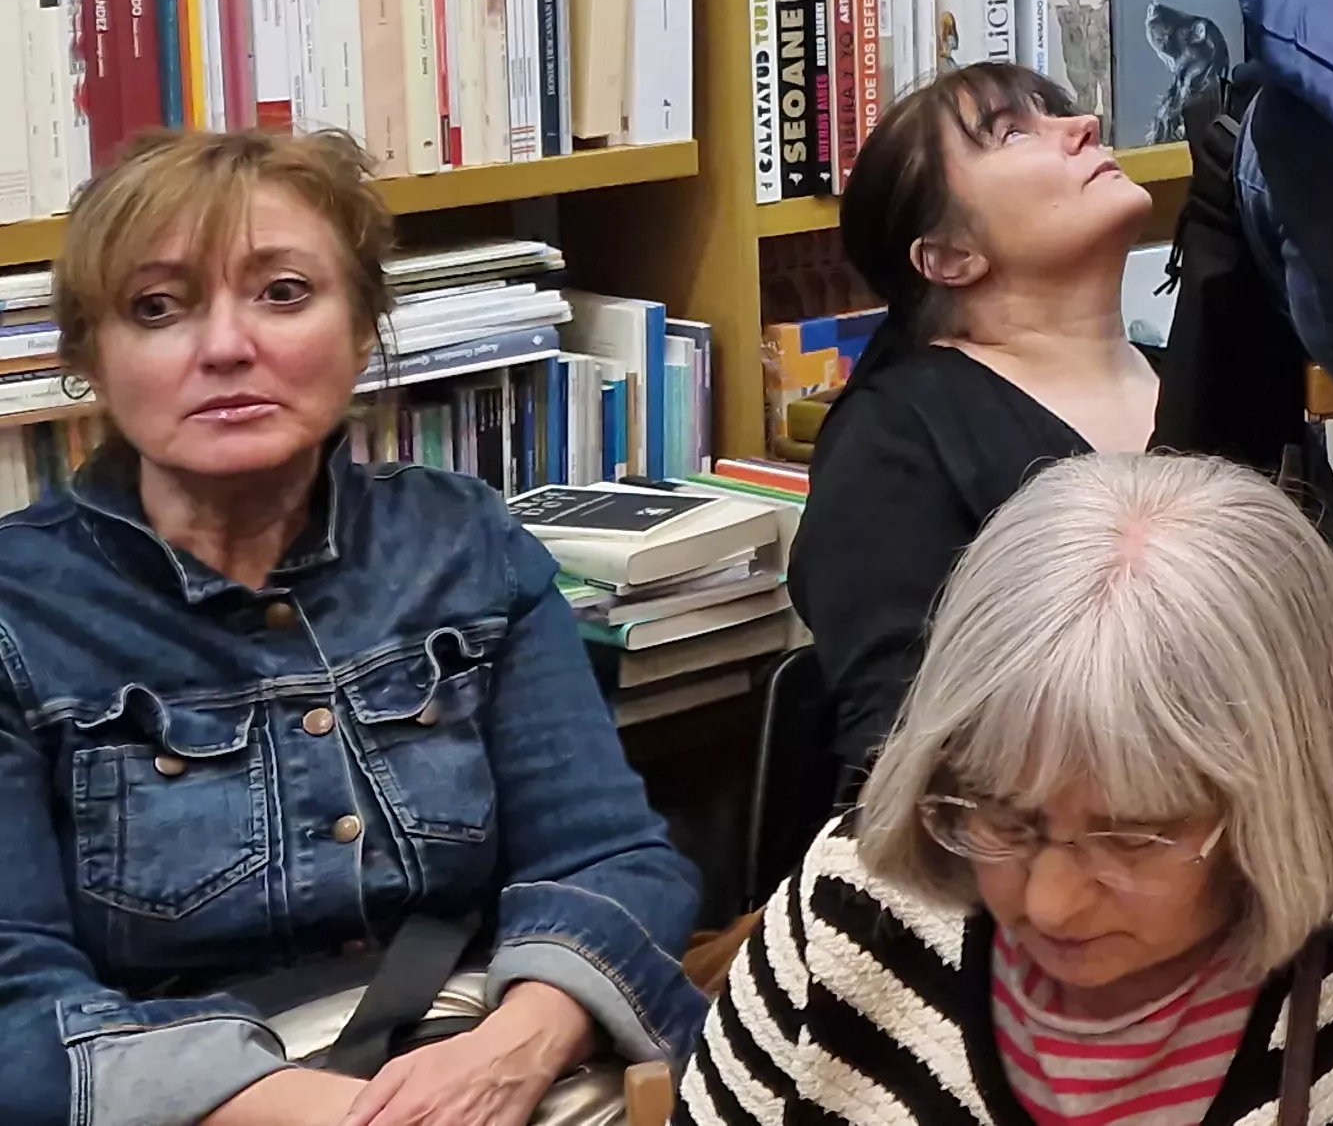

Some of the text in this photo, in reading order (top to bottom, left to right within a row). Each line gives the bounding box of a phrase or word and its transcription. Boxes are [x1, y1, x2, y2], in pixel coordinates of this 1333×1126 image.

[863, 40, 877, 75] LOS
[780, 7, 807, 165] SEOANE
[864, 77, 877, 99] DE
[754, 50, 773, 174] CALATAYUD
[866, 102, 878, 134] BRO
